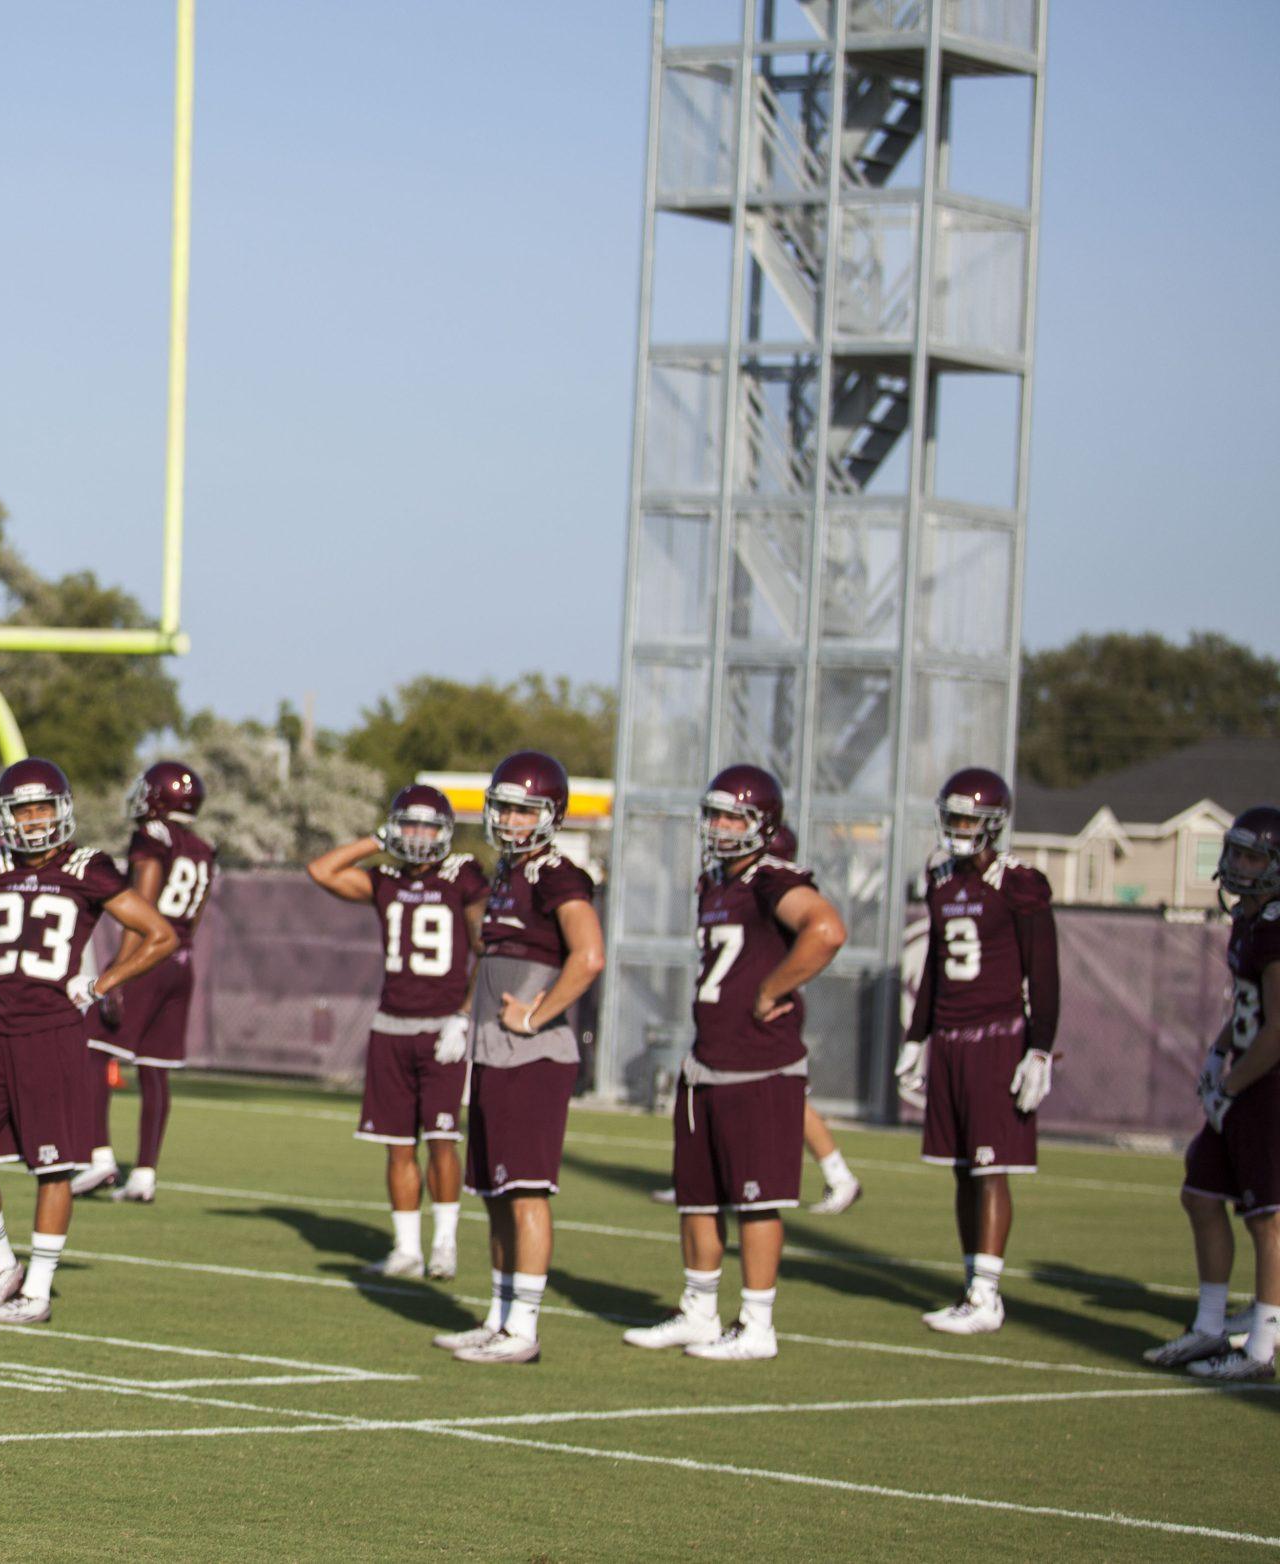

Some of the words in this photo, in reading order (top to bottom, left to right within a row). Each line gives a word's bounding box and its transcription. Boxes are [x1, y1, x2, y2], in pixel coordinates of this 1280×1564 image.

[157, 857, 210, 919] 81
[385, 901, 454, 977] 19
[697, 924, 745, 1004] 7
[944, 916, 982, 981] 3
